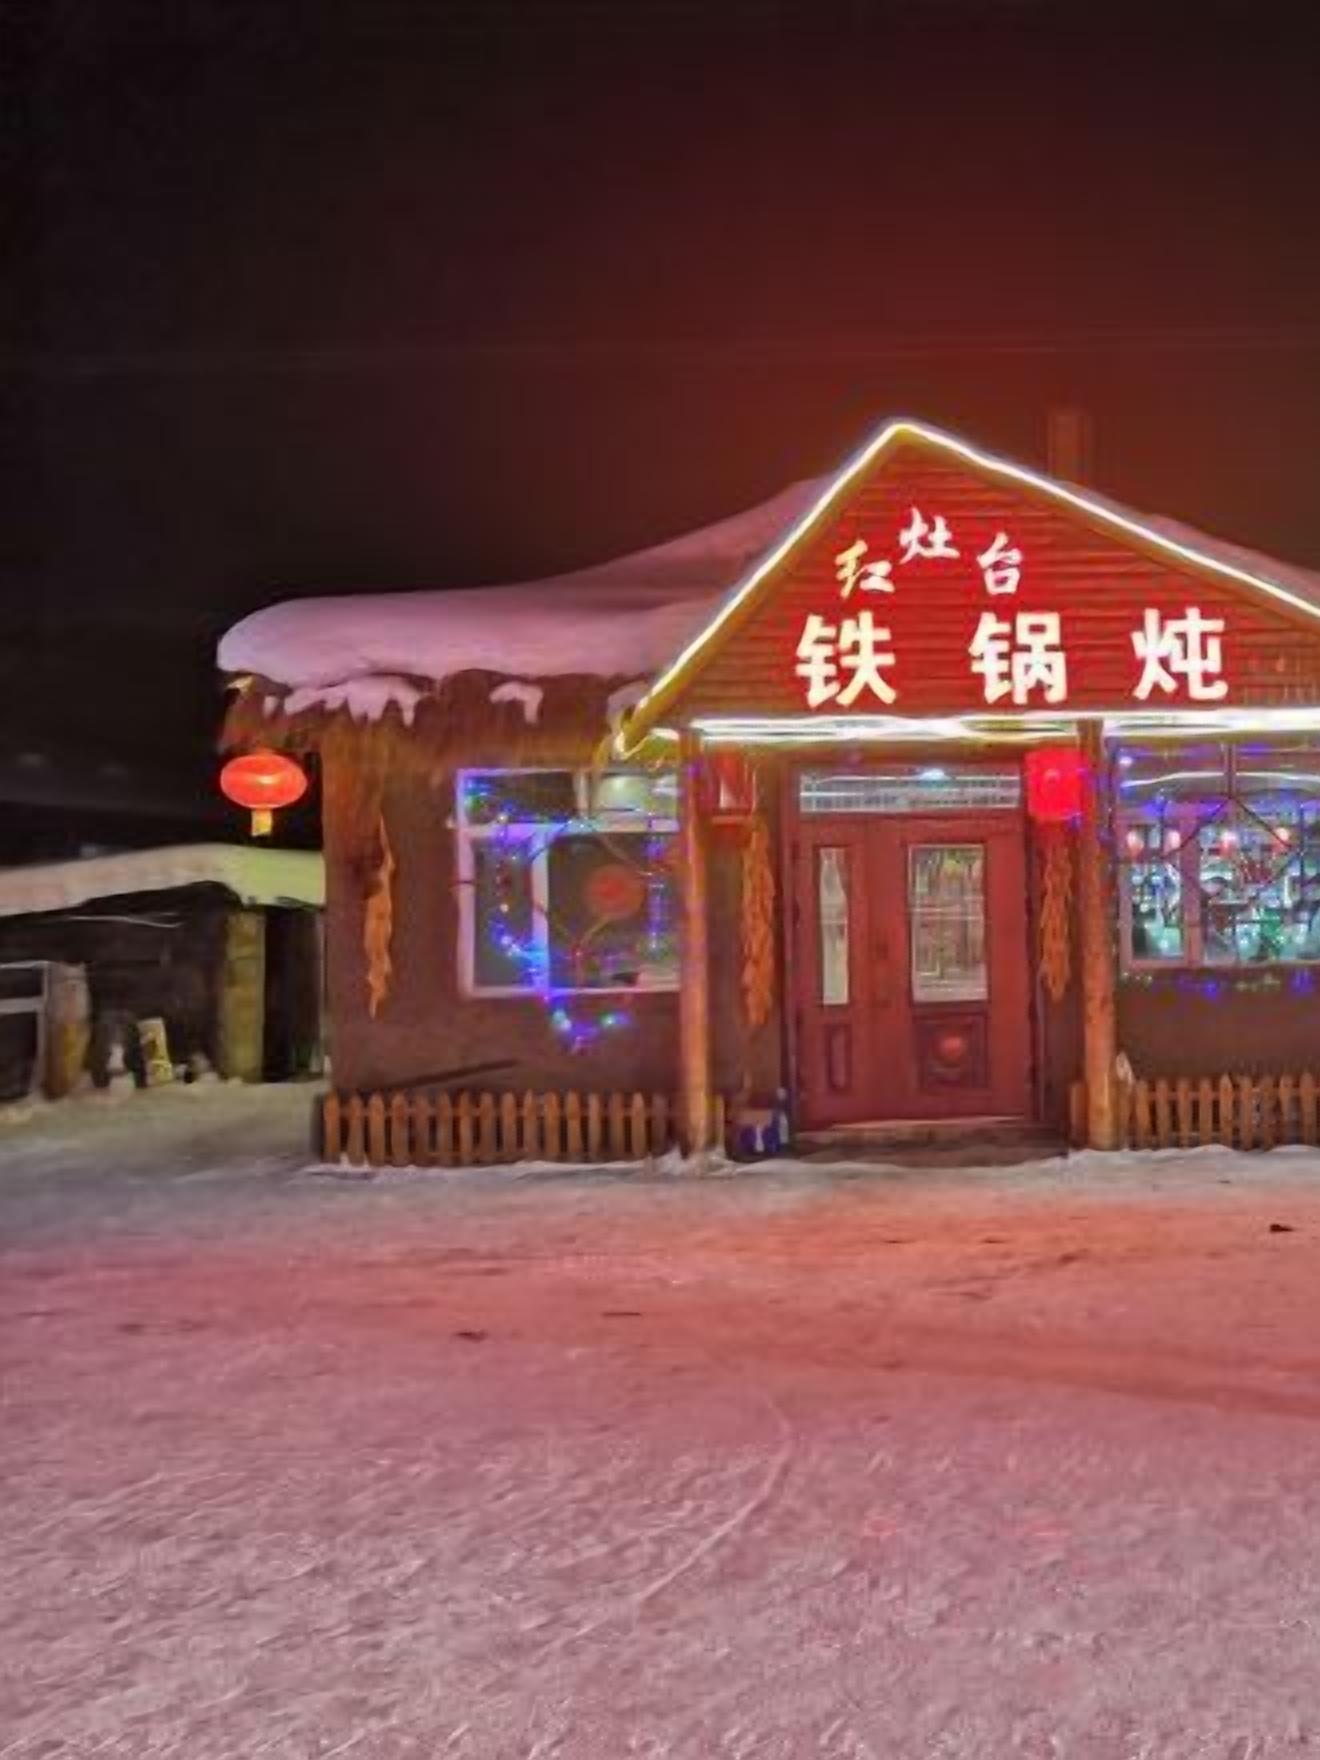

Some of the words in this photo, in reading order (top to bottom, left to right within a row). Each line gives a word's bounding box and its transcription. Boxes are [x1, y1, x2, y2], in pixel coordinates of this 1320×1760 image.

[835, 507, 1024, 598] 红灶台
[795, 607, 1228, 707] 铁锅炖
